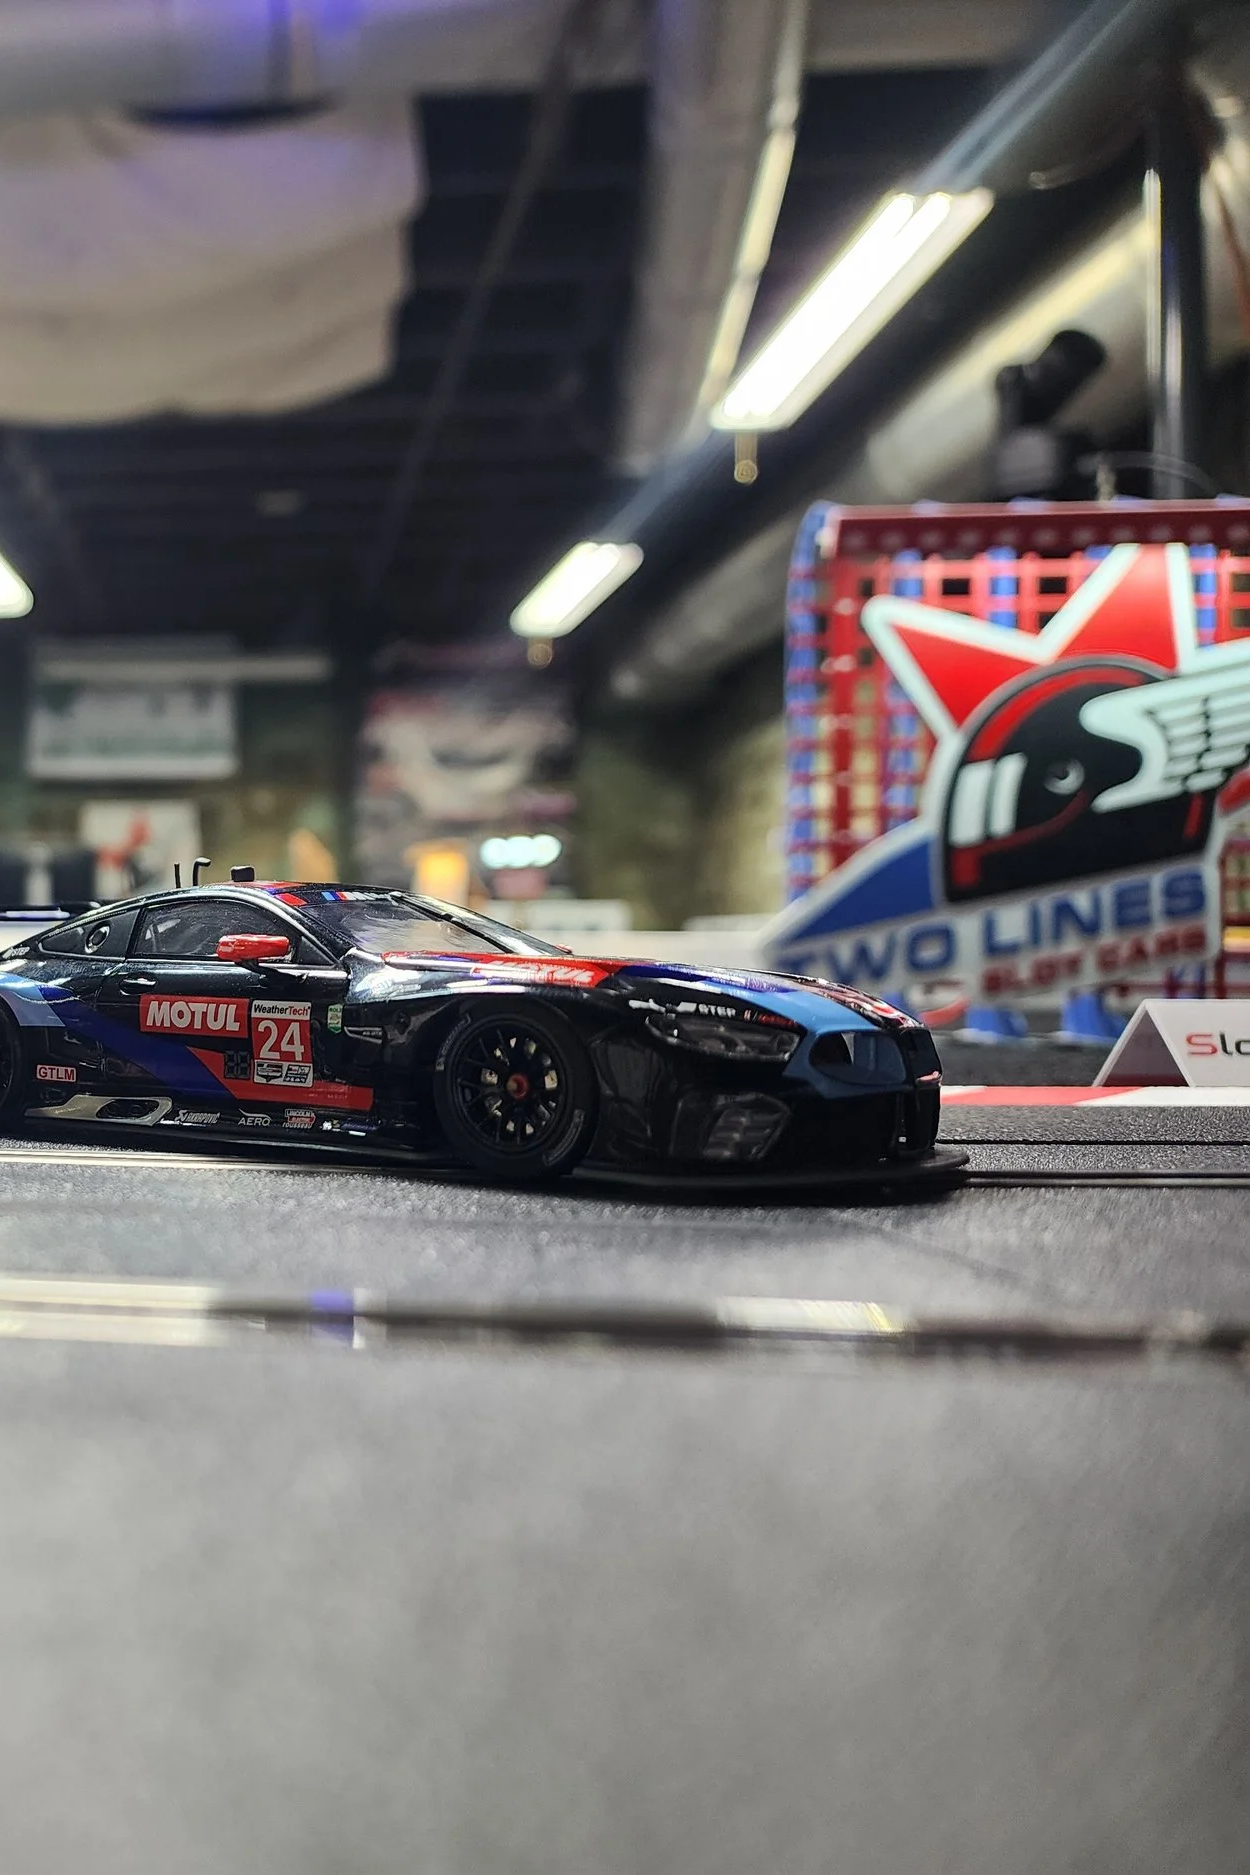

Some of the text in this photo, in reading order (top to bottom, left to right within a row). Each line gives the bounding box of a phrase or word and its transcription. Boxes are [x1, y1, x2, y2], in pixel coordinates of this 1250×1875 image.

[781, 866, 1207, 984] TWO LINES
[980, 926, 1207, 995] SLOT CARS
[146, 1001, 240, 1031] MOTUL
[253, 1004, 311, 1016] WeatherTech
[257, 1020, 305, 1061] 24
[38, 1066, 75, 1081] GTLM
[238, 1116, 271, 1126] AERO
